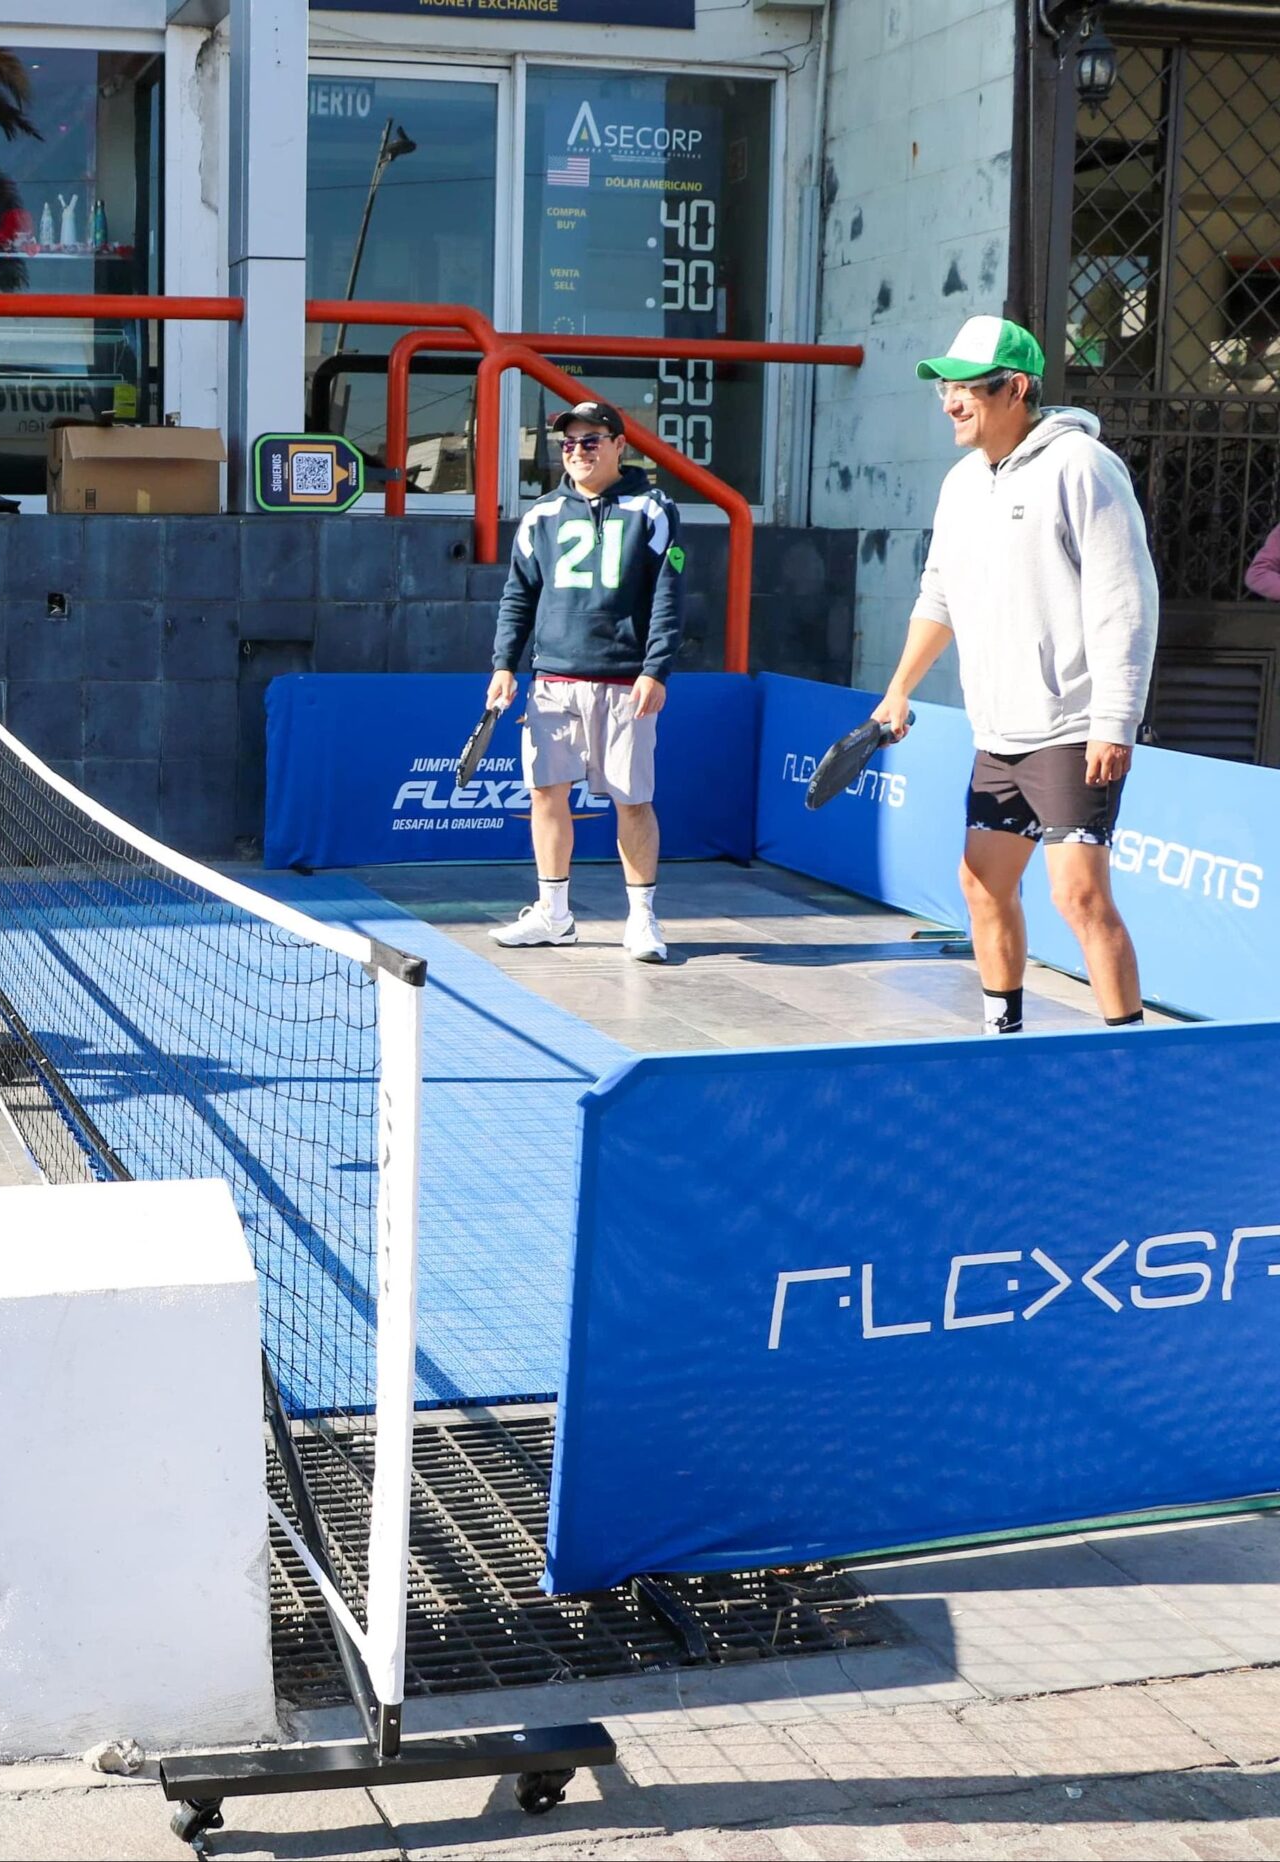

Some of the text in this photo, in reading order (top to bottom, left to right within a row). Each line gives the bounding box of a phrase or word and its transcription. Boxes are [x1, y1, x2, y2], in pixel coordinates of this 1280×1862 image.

[479, 0, 558, 11] EXCHANGE
[310, 85, 371, 117] IERTO
[567, 100, 703, 151] ASECORP
[605, 177, 702, 191] DÓLAR AMERICANO
[547, 207, 586, 217] COMPRA
[557, 220, 576, 230] BUY
[550, 268, 580, 278] VENTA
[554, 281, 575, 290] SELL
[271, 453, 283, 492] SÍGUENOS
[554, 519, 624, 589] 21
[410, 758, 516, 772] JUMPI PARK
[392, 780, 610, 810] FLEXZNE
[392, 818, 504, 831] DESAFIA LA GRAVEDAD
